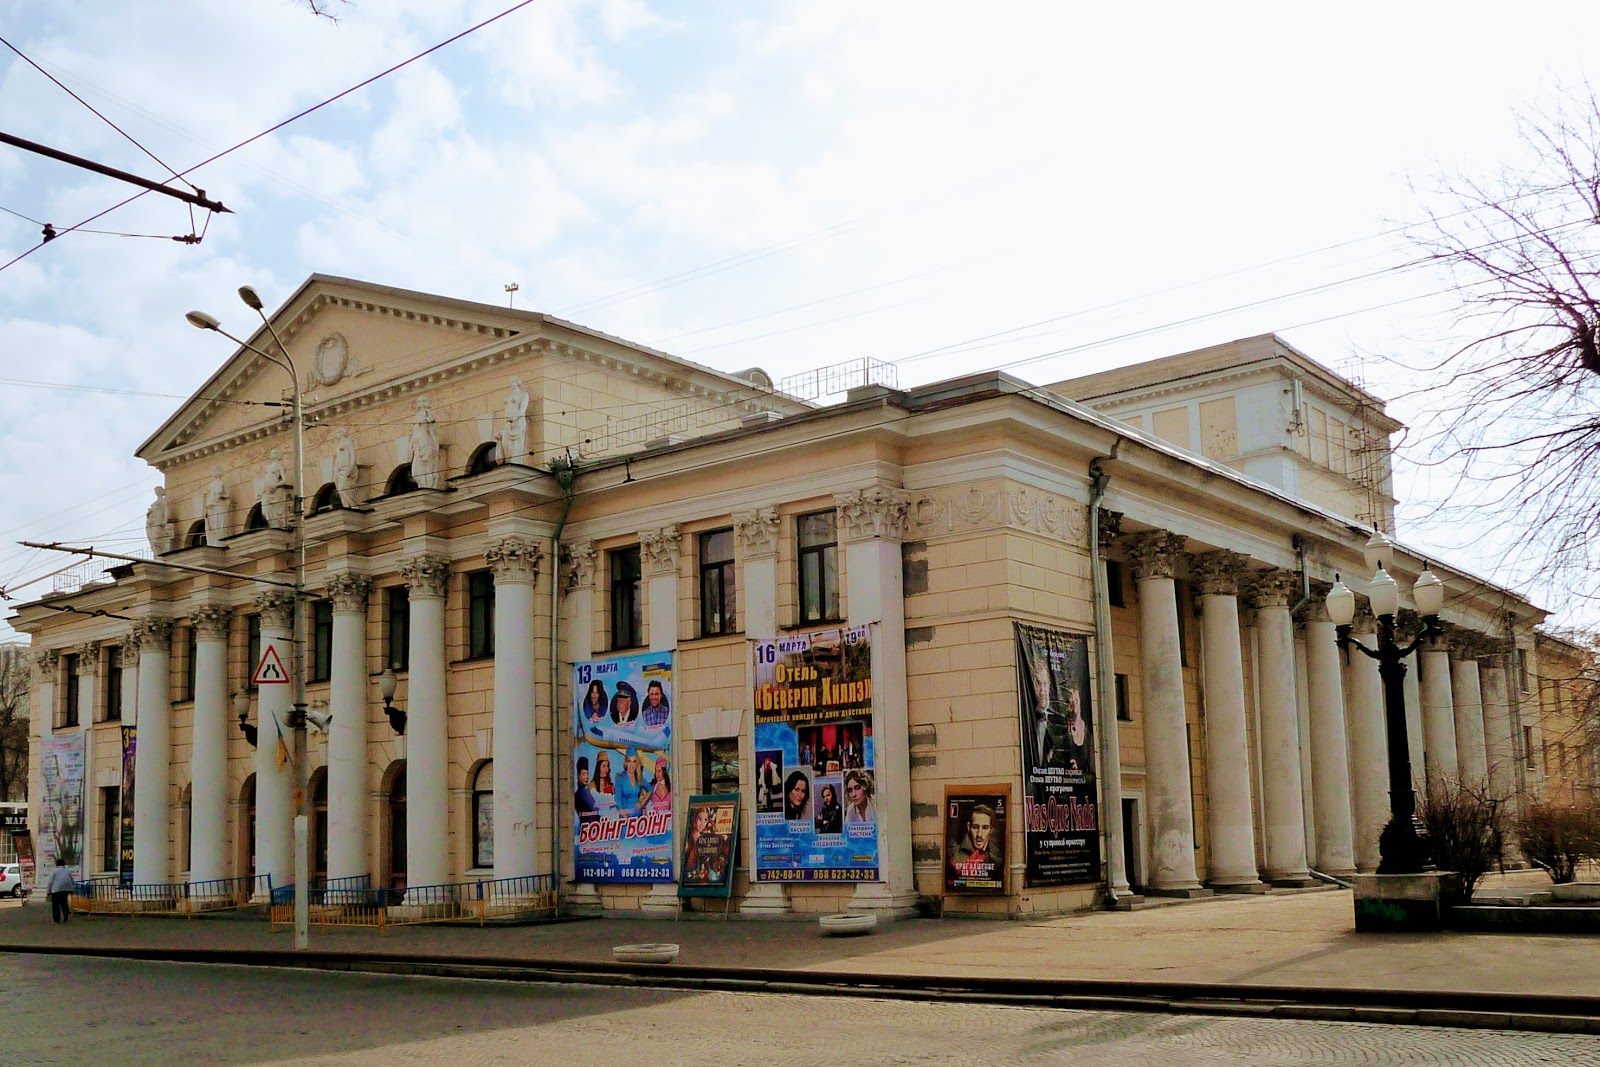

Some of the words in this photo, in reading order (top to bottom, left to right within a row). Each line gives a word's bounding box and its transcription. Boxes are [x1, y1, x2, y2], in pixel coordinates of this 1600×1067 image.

[756, 644, 775, 663] 16
[779, 641, 807, 652] МАРТА
[577, 664, 592, 684] 13
[596, 662, 618, 674] МАРТА
[123, 728, 129, 748] 3
[997, 799, 1003, 807] 5
[621, 868, 635, 877] 068
[813, 869, 829, 879] 068
